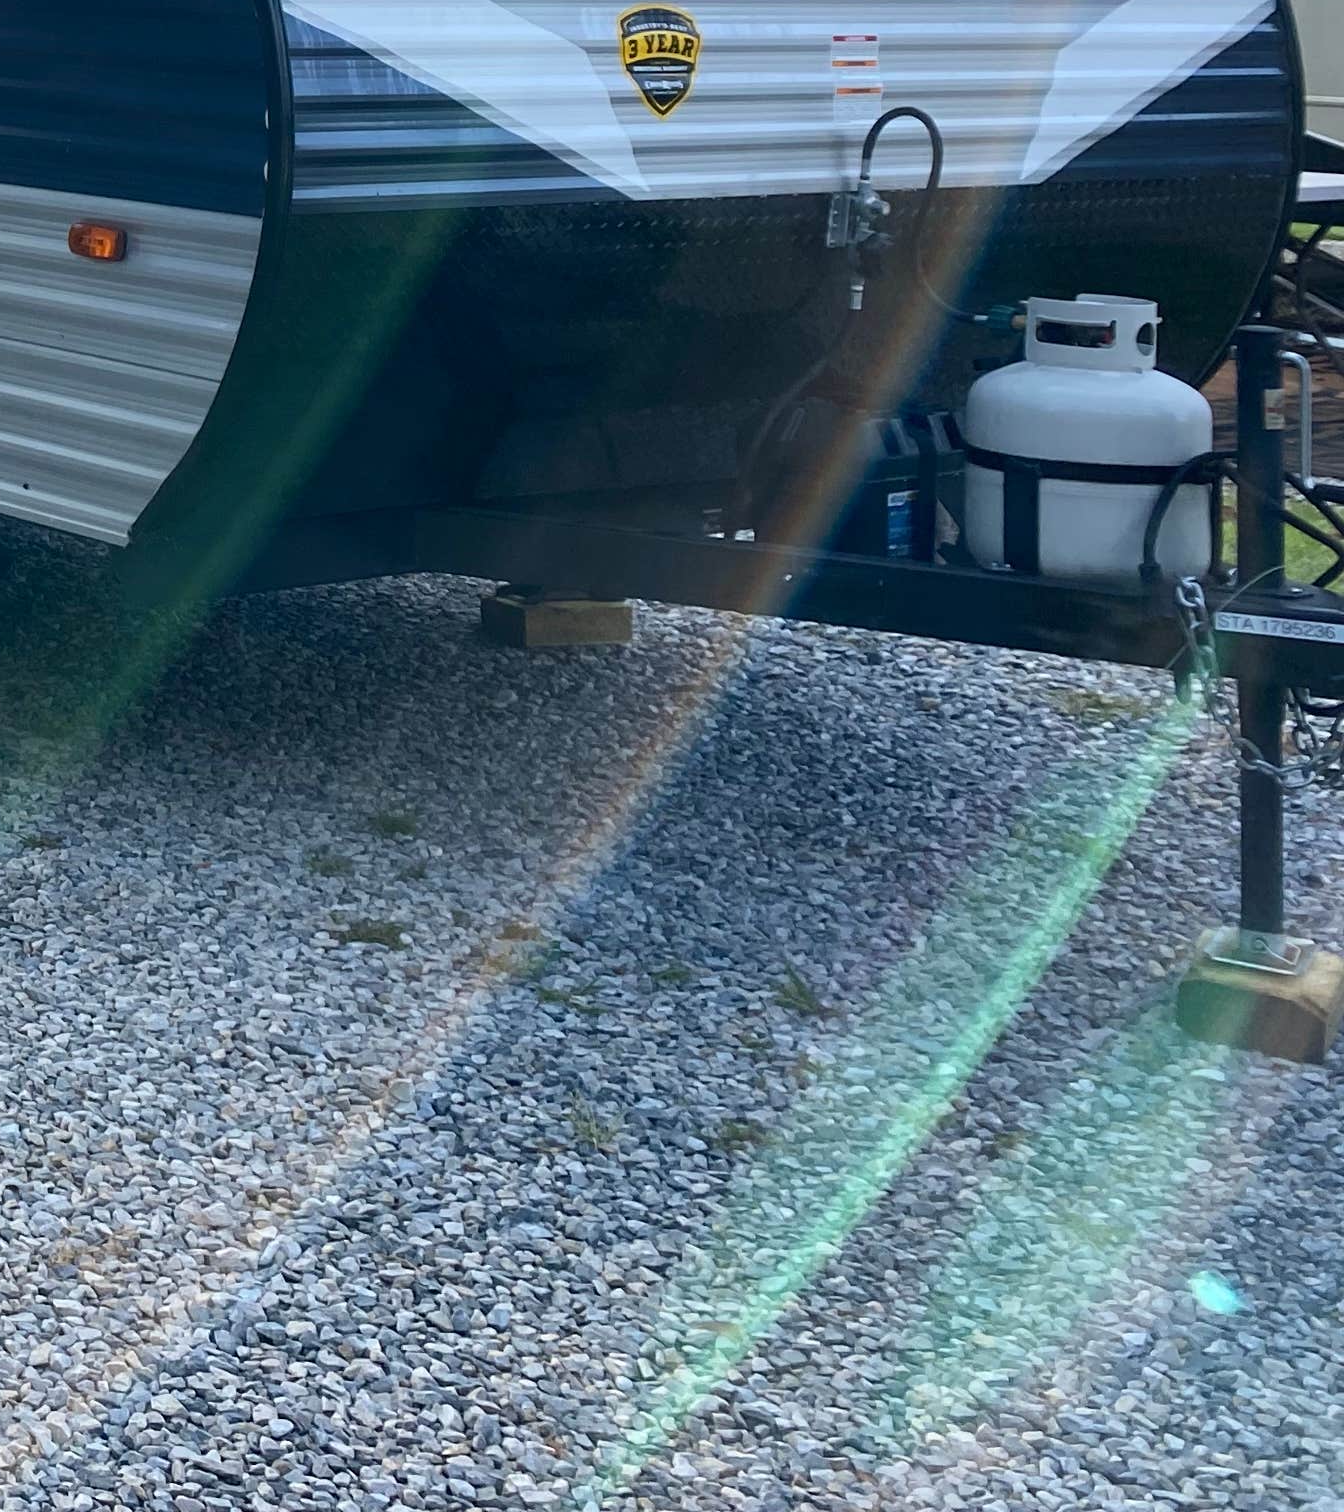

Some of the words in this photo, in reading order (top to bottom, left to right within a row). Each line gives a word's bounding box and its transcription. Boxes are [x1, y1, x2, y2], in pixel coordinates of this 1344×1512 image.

[628, 40, 638, 58] 3
[644, 34, 694, 57] YEAR
[1218, 614, 1255, 631] STA
